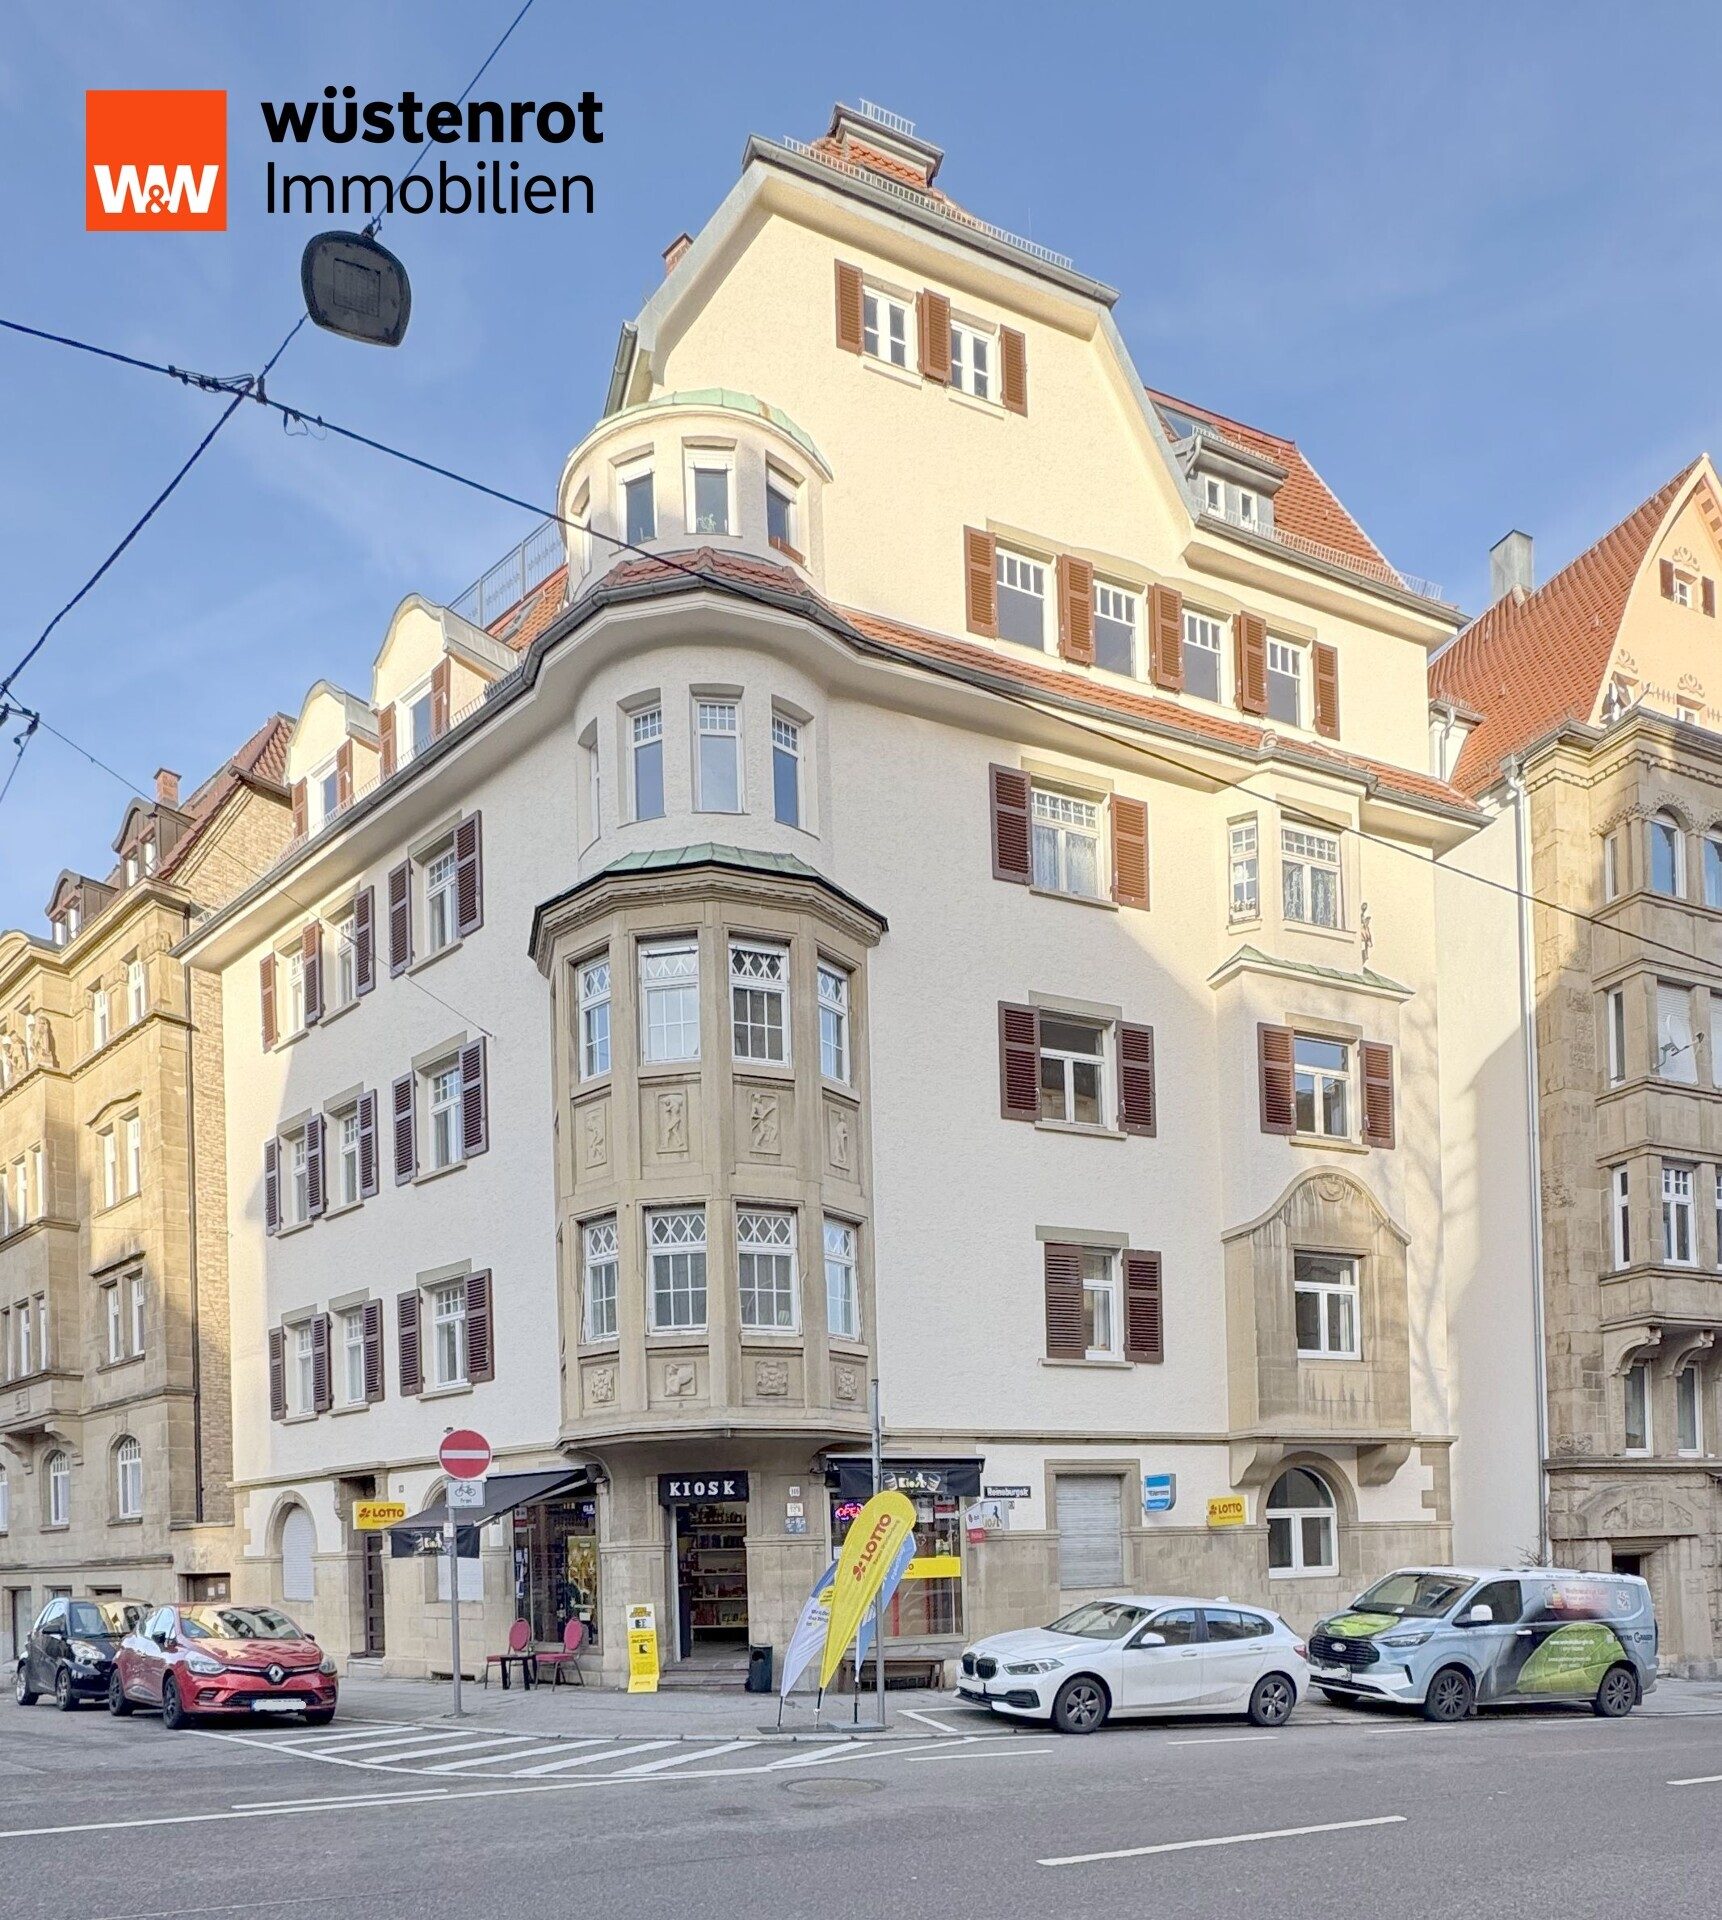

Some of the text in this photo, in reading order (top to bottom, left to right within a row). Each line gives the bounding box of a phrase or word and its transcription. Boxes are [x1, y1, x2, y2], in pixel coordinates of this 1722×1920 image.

[669, 1480, 735, 1497] KIOSK
[372, 1508, 404, 1518] LOTTO
[1218, 1502, 1242, 1514] LOTTO
[860, 1513, 891, 1562] LOTTO
